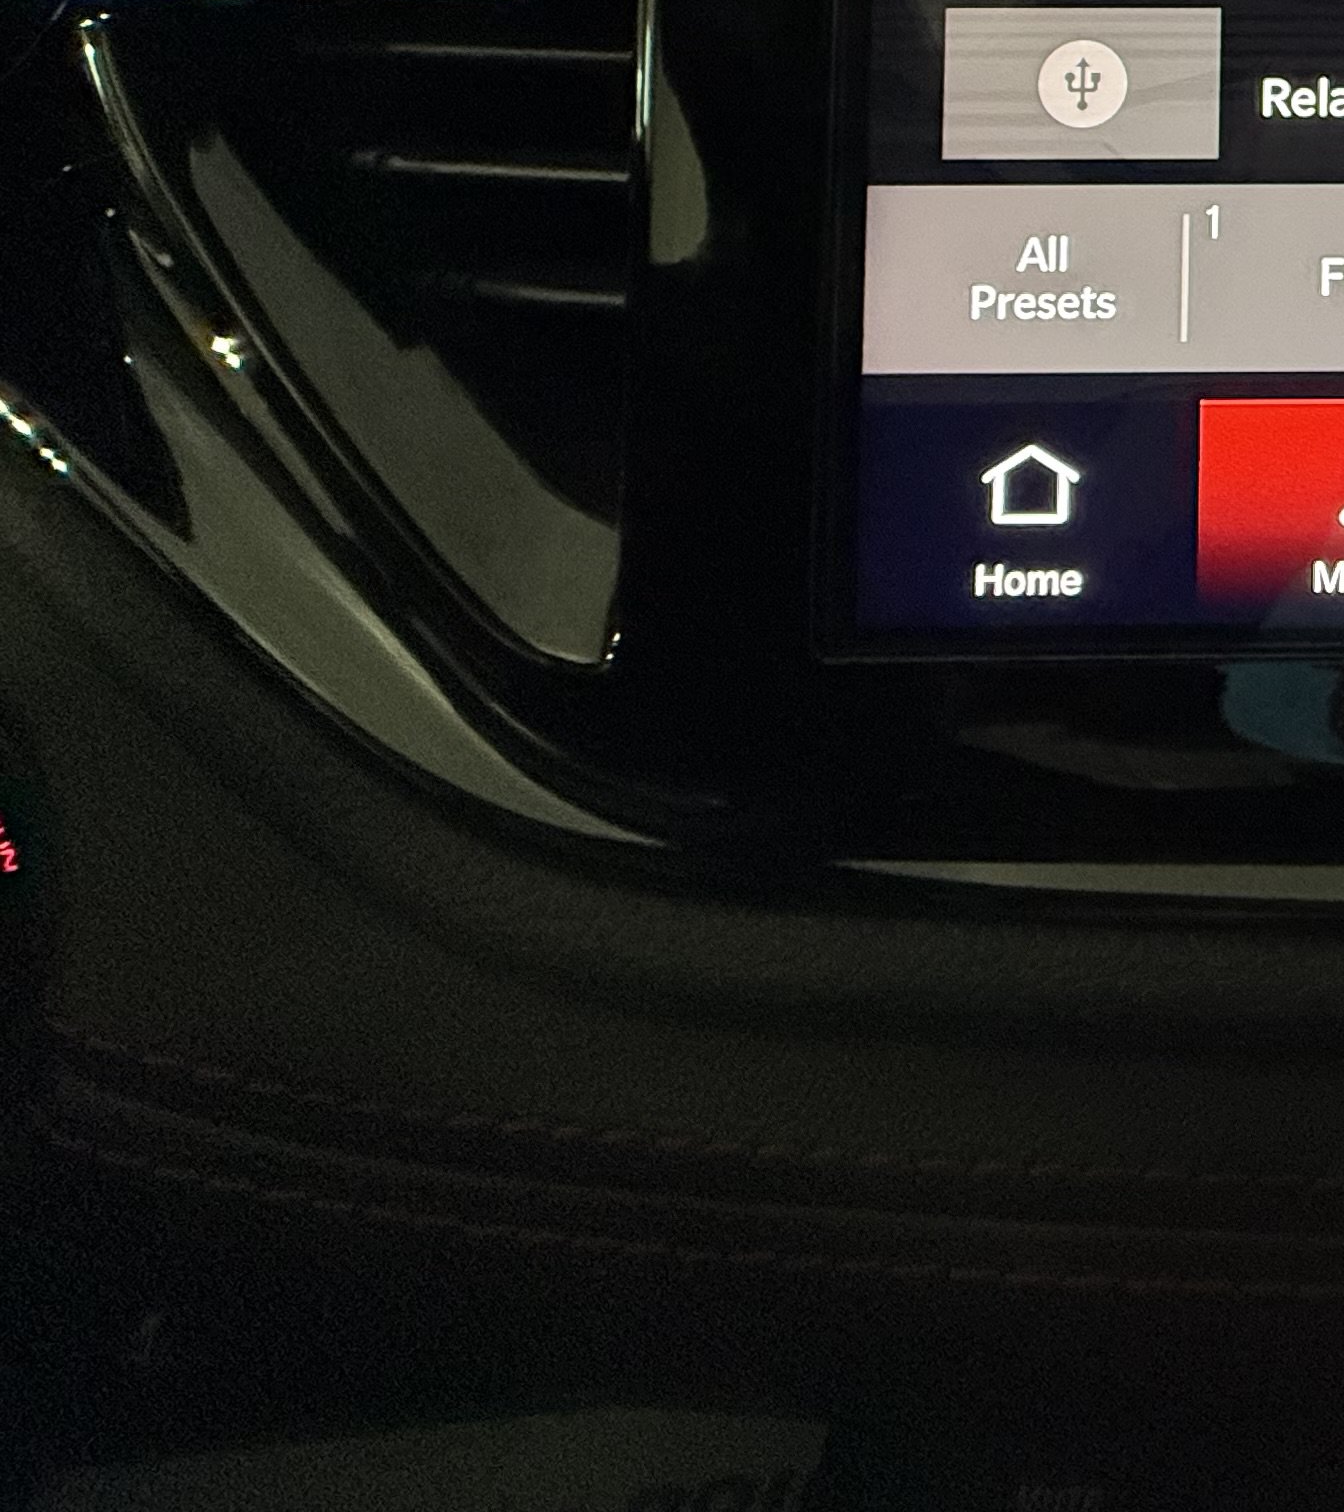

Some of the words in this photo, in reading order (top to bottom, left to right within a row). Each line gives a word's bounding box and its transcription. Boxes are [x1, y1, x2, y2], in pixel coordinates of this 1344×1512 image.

[1204, 203, 1220, 241] 1
[1015, 234, 1070, 274] All
[970, 284, 1118, 322] Presets
[973, 562, 1085, 598] Home
